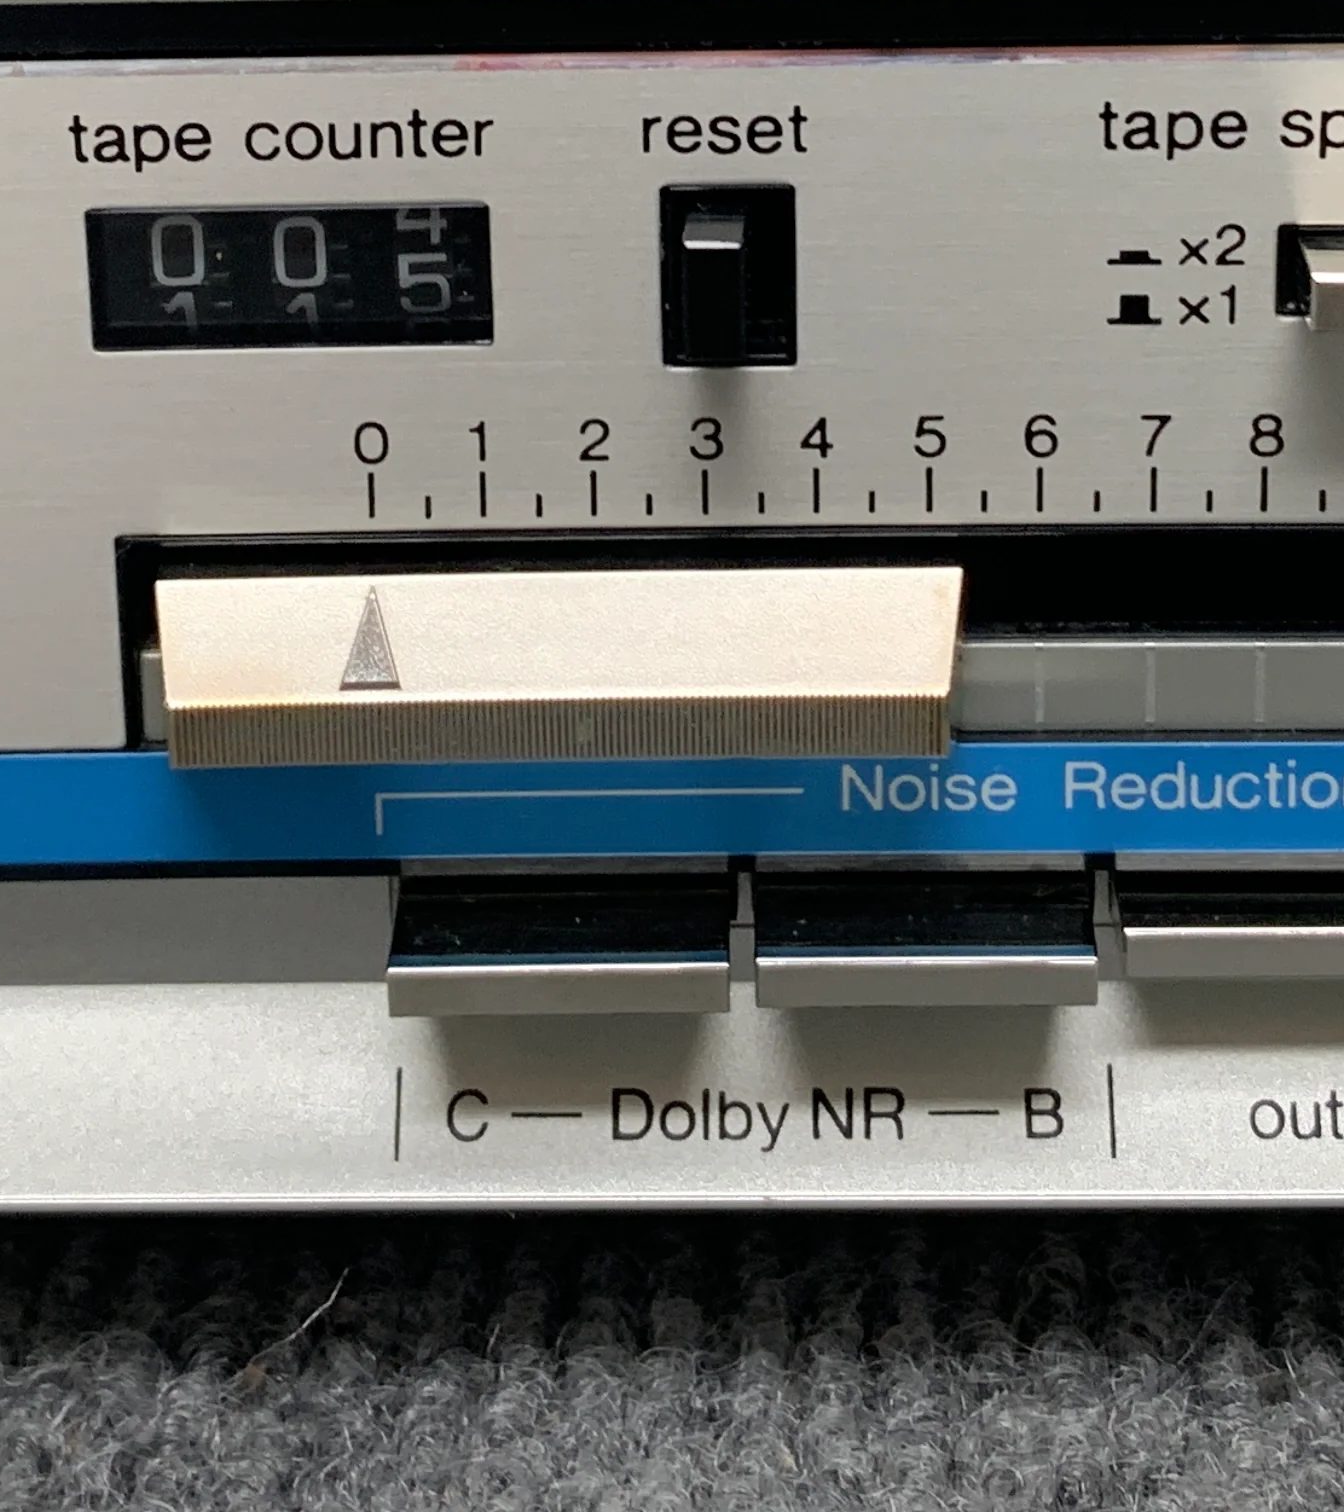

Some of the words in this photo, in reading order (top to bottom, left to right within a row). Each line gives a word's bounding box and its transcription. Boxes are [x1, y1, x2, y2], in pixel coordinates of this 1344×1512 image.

[67, 113, 213, 174] tape
[243, 107, 495, 162] counter
[641, 104, 809, 156] reset
[1097, 100, 1249, 162] tape
[1177, 222, 1248, 267] x2
[1177, 283, 1238, 326] x1
[353, 420, 390, 466] 0
[467, 419, 488, 463] 1
[578, 417, 611, 463] 2
[688, 415, 725, 462] 3
[799, 415, 835, 460] 4
[913, 414, 948, 460] 5
[1023, 413, 1060, 460] 6
[1139, 413, 1173, 458] 7
[1248, 412, 1286, 459] 8
[840, 761, 1019, 813] Noise
[445, 1087, 490, 1144] C
[610, 1087, 791, 1154] Dolby
[810, 1086, 906, 1142] NR
[1023, 1087, 1066, 1141] B
[1248, 1089, 1344, 1142] out
